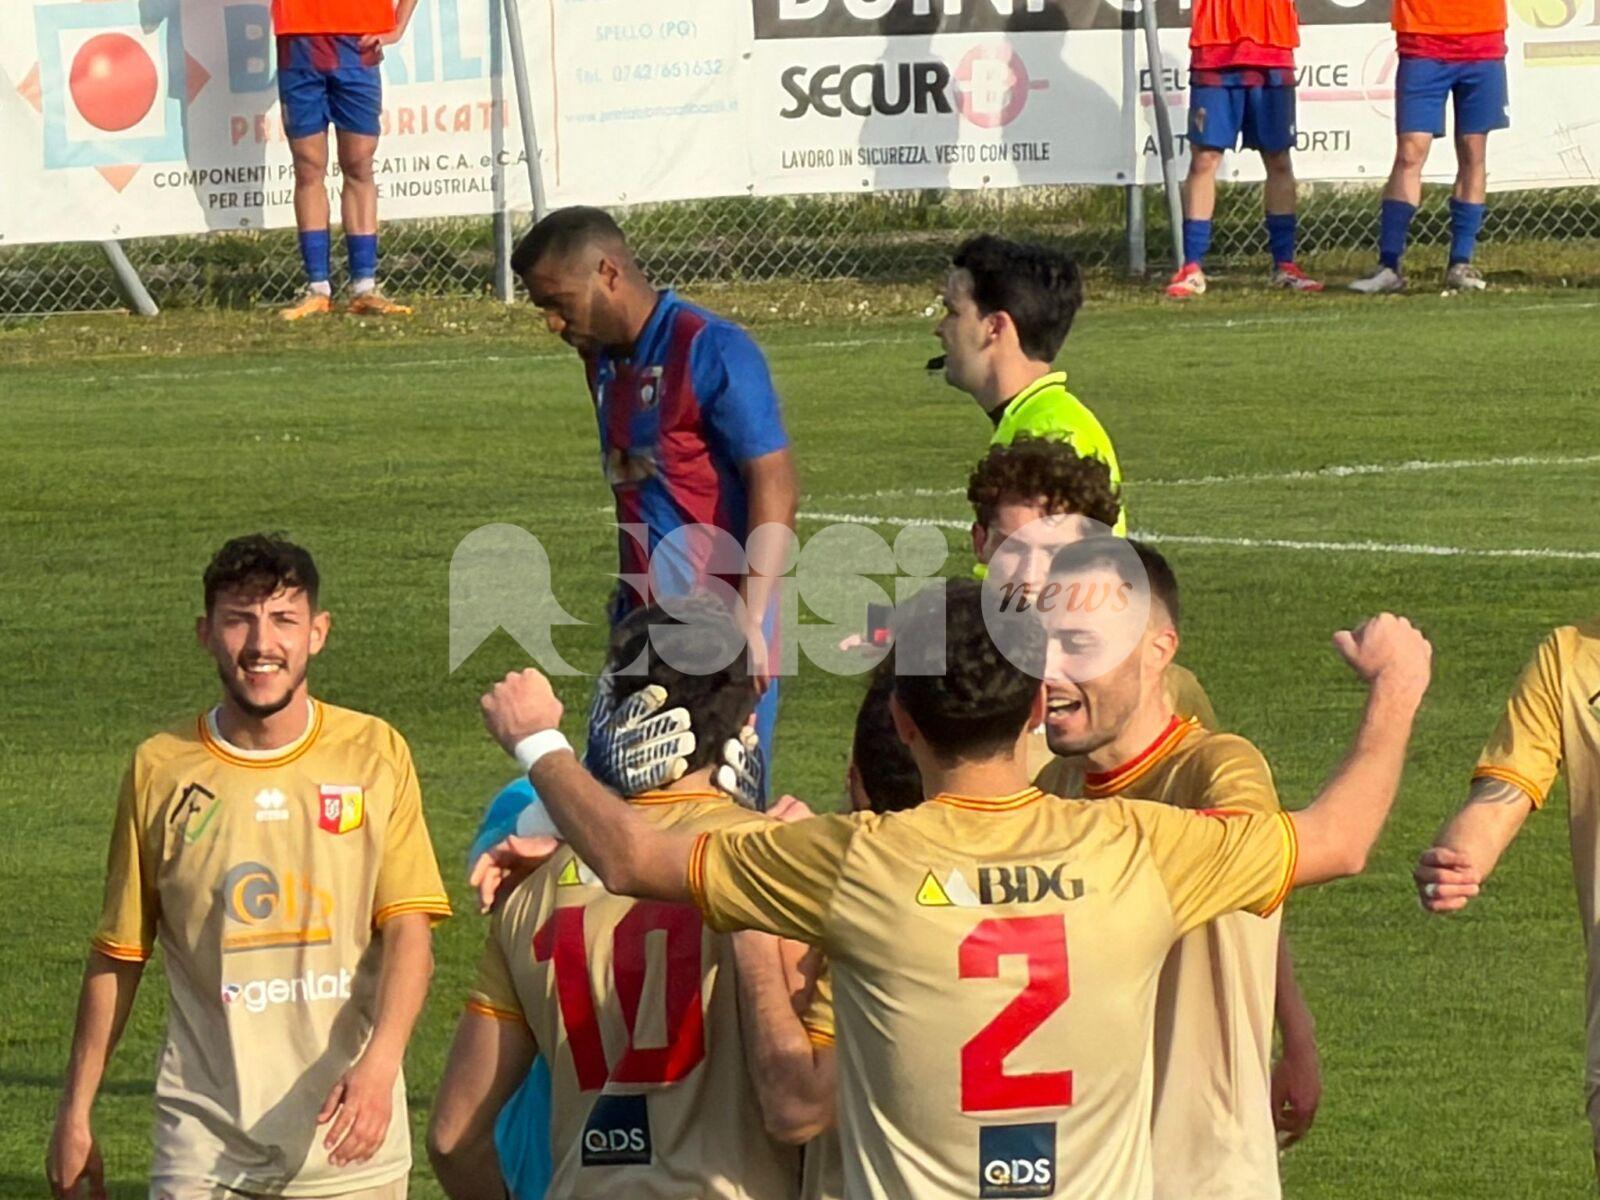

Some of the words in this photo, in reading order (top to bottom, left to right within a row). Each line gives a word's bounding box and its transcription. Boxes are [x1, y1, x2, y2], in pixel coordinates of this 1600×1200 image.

[779, 63, 952, 119] SECUR
[153, 165, 272, 188] COMPONENTI
[413, 155, 430, 173] IN
[436, 153, 474, 171] C.A.
[782, 150, 834, 169] LAVORO
[839, 148, 853, 166] IN
[935, 144, 976, 164] VESTO
[979, 143, 1008, 162] CON
[1011, 142, 1050, 162] STILE
[208, 192, 238, 209] PER
[390, 174, 499, 198] INDUSTRIALE
[977, 862, 1085, 906] BDG
[532, 902, 706, 1092] 10
[958, 914, 1073, 1111] 2
[585, 1127, 645, 1152] QDS
[984, 1158, 1051, 1185] QDS
